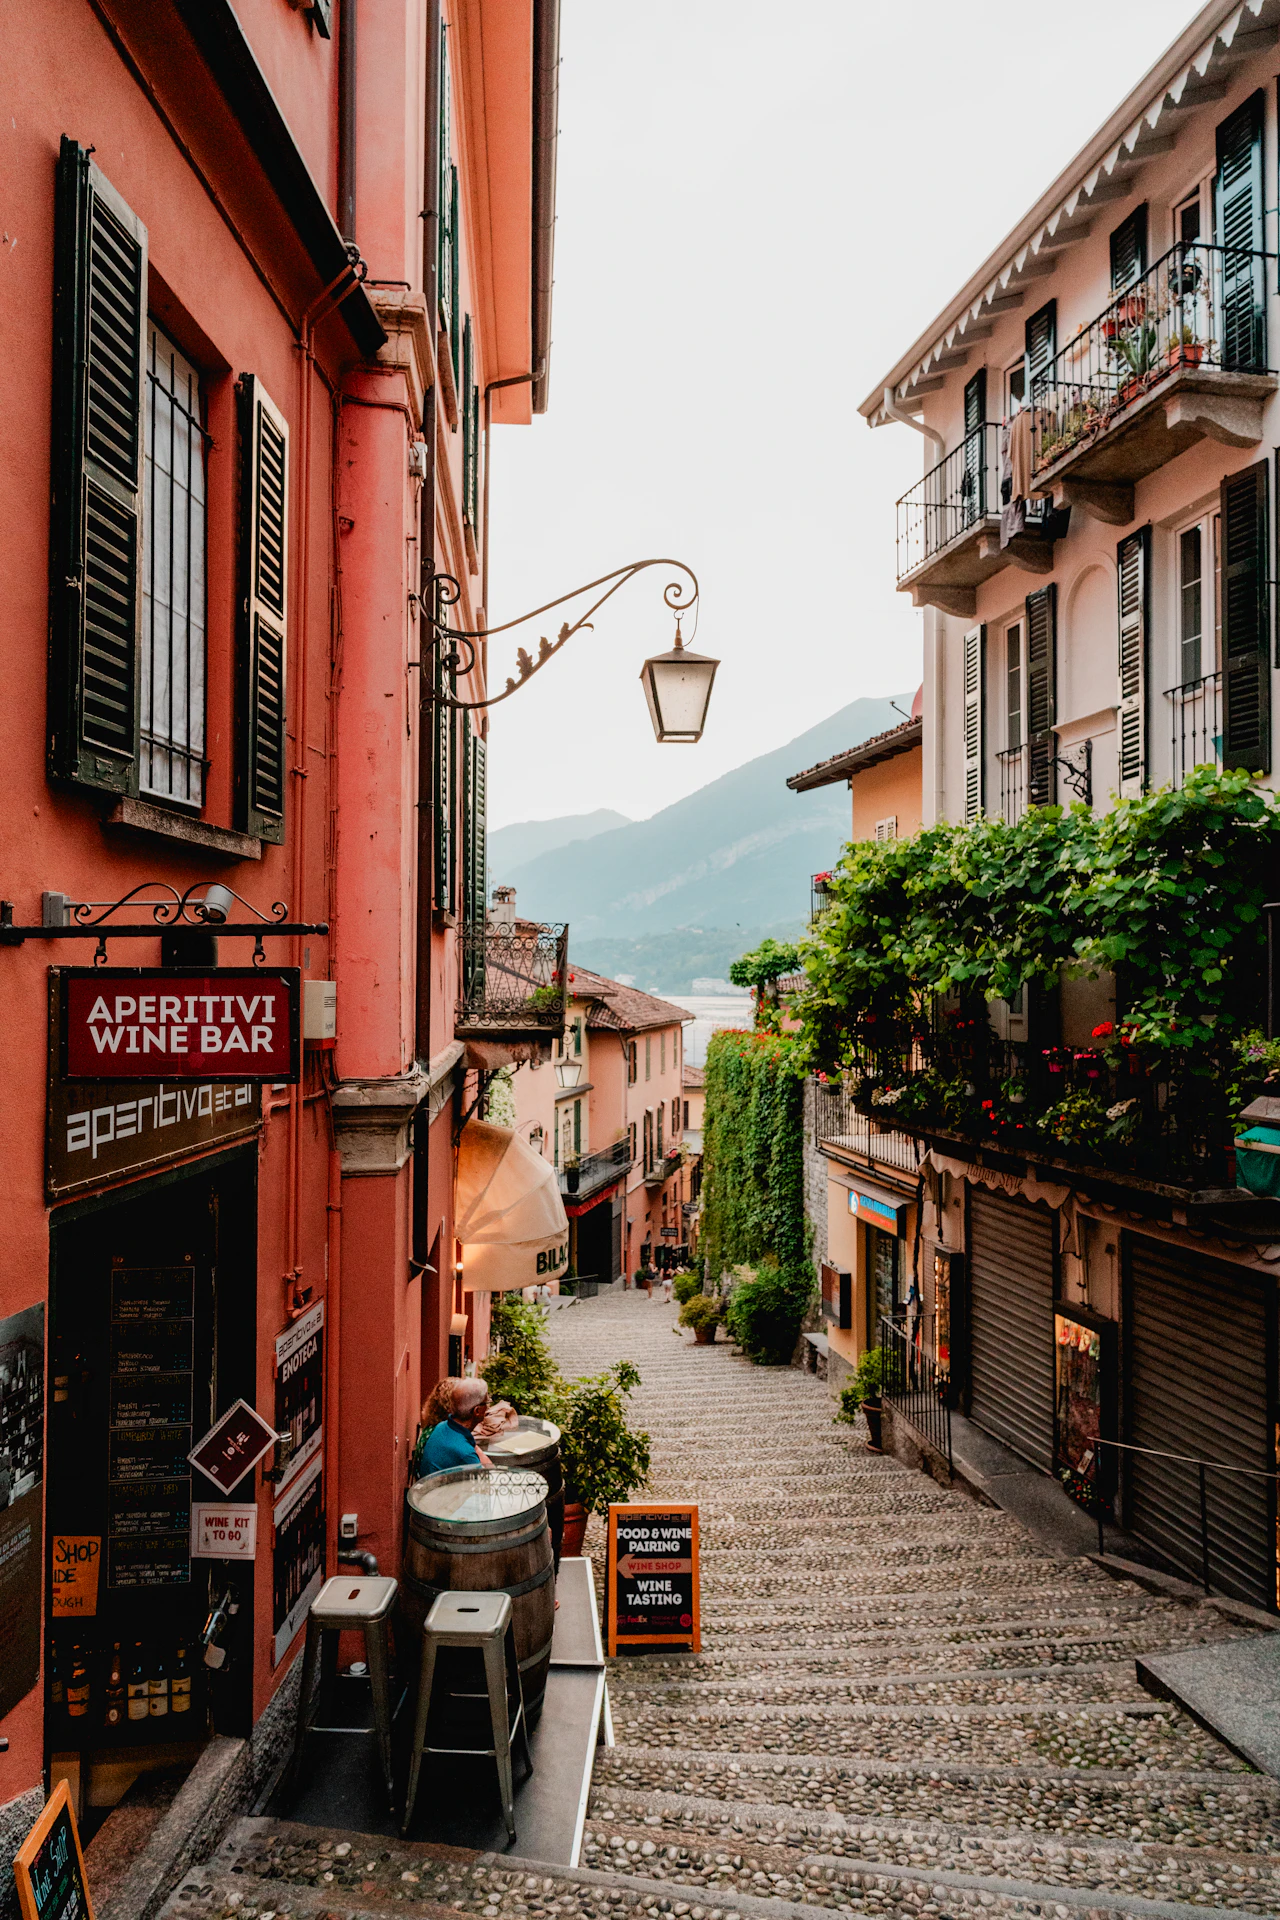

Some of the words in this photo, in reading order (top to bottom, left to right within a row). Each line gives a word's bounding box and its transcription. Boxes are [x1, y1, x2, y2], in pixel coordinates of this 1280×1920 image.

[86, 995, 276, 1024] APERITIVI
[89, 1025, 189, 1054] WINE
[200, 1025, 274, 1054] BAR
[66, 1083, 213, 1160] aperitivo
[282, 1335, 318, 1384] ENOTECA
[205, 1517, 229, 1528] WINE
[234, 1517, 250, 1528] KIT
[212, 1530, 226, 1540] TO
[228, 1530, 241, 1541] GO
[616, 1528, 650, 1540] FOOD
[651, 1528, 660, 1540] &
[660, 1528, 692, 1540] WINE
[55, 1539, 99, 1564] SHOP
[629, 1541, 681, 1553] PAIRING
[627, 1562, 653, 1570] WINE
[655, 1562, 682, 1570] SHOP
[637, 1580, 672, 1592] WINE
[626, 1593, 683, 1606] TASTING
